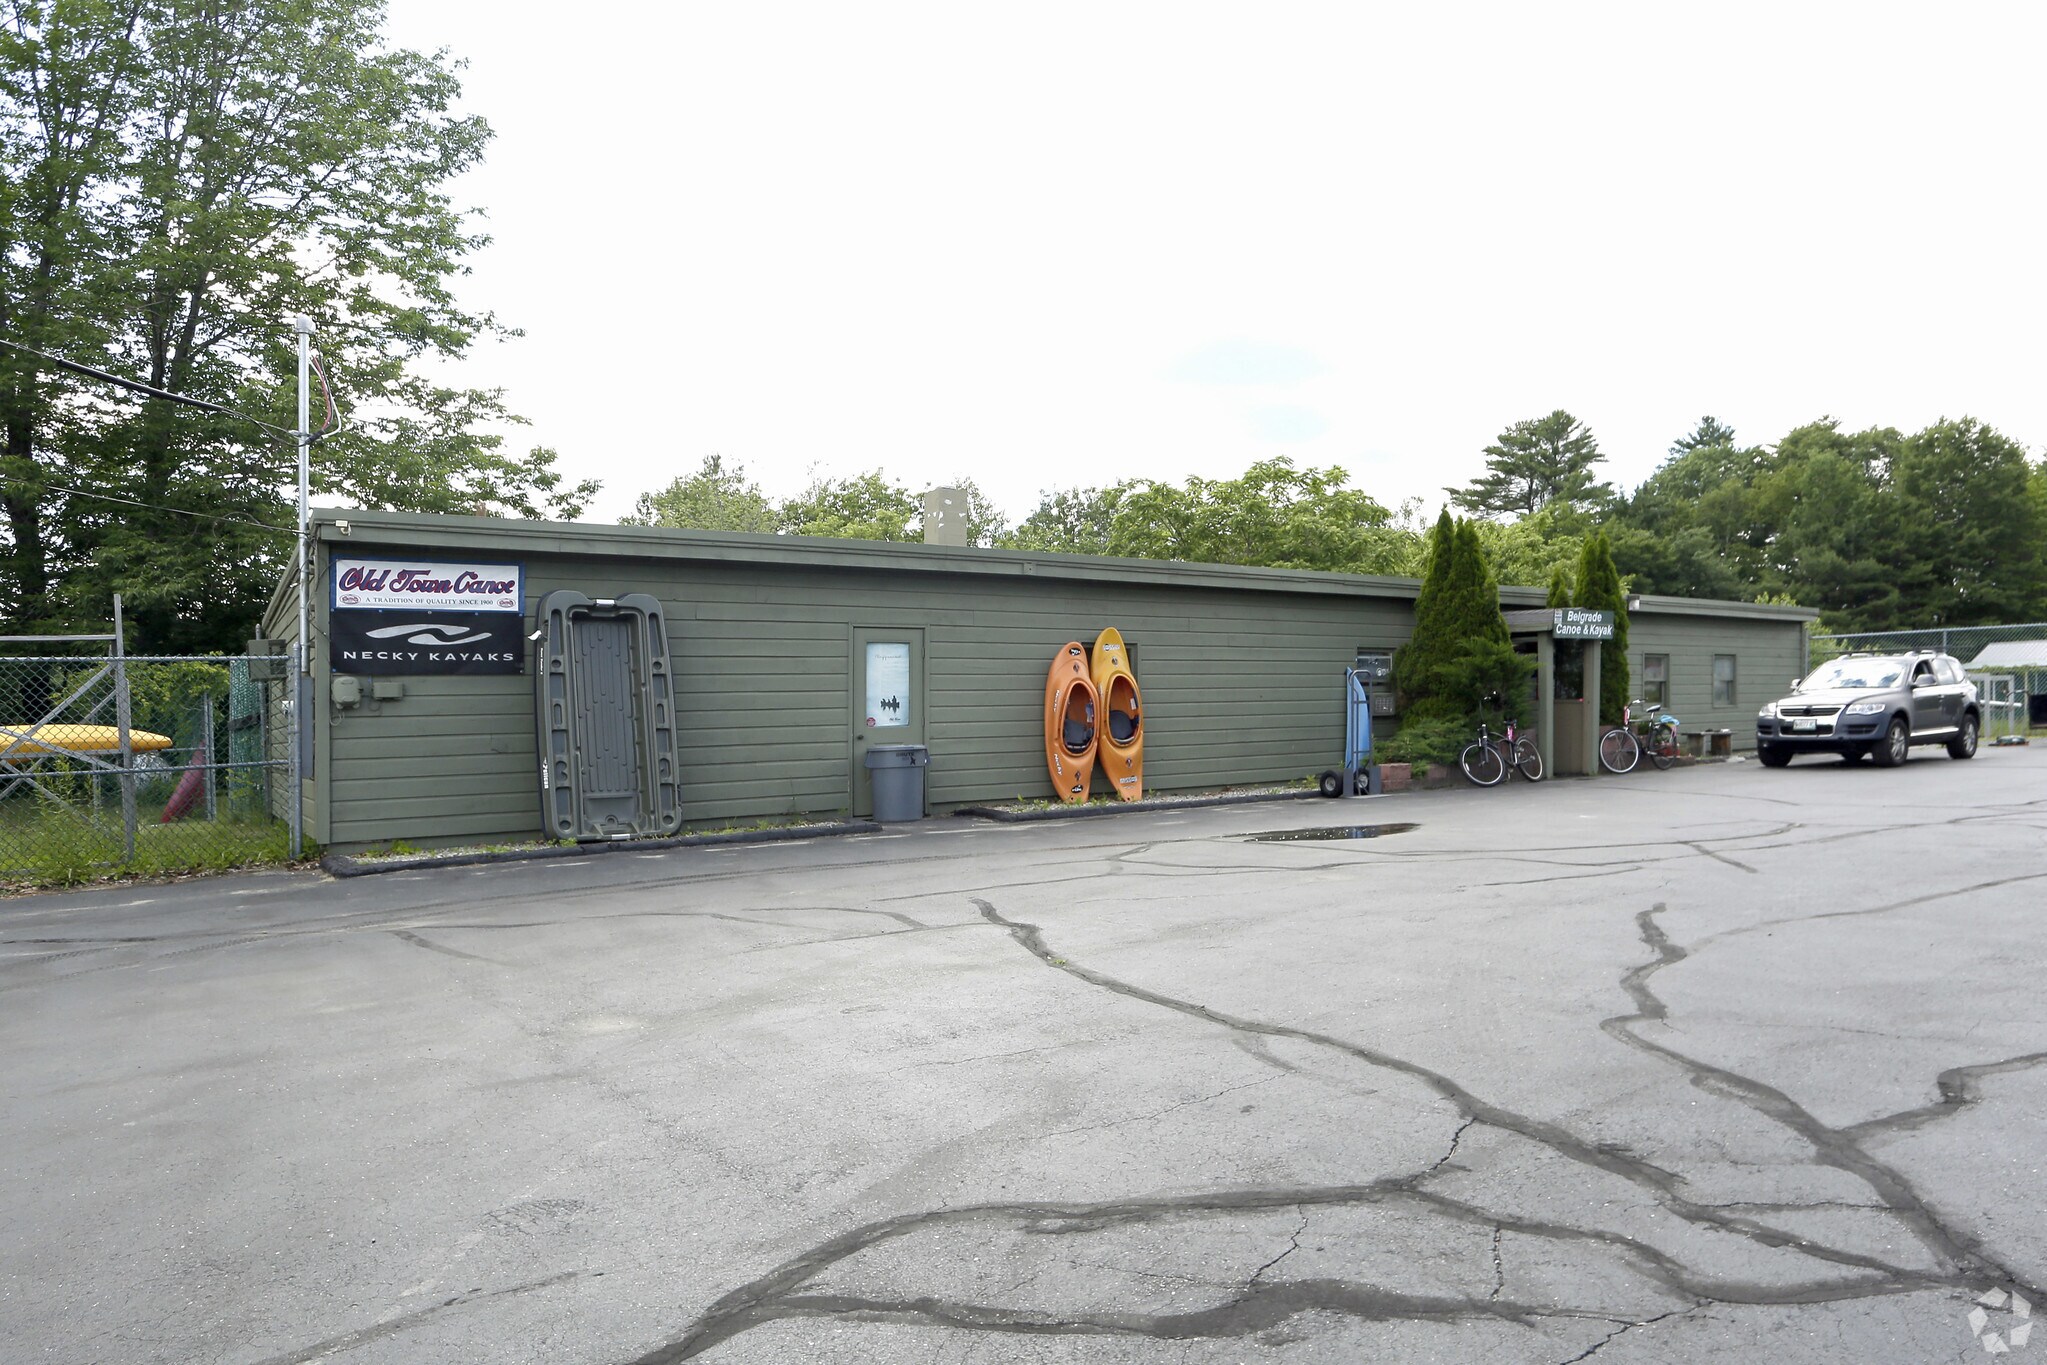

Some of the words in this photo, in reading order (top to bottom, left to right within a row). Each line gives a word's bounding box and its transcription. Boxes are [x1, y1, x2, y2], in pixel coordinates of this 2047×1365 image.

[339, 566, 391, 591] Old
[389, 569, 454, 593] Town
[453, 571, 516, 595] Canoe
[1567, 611, 1602, 624] Belgrade
[1556, 623, 1581, 635] Canoe
[1583, 625, 1589, 635] &
[1589, 624, 1613, 638] Kayak
[343, 651, 418, 661] NECKY
[429, 652, 514, 661] KAYAKS
